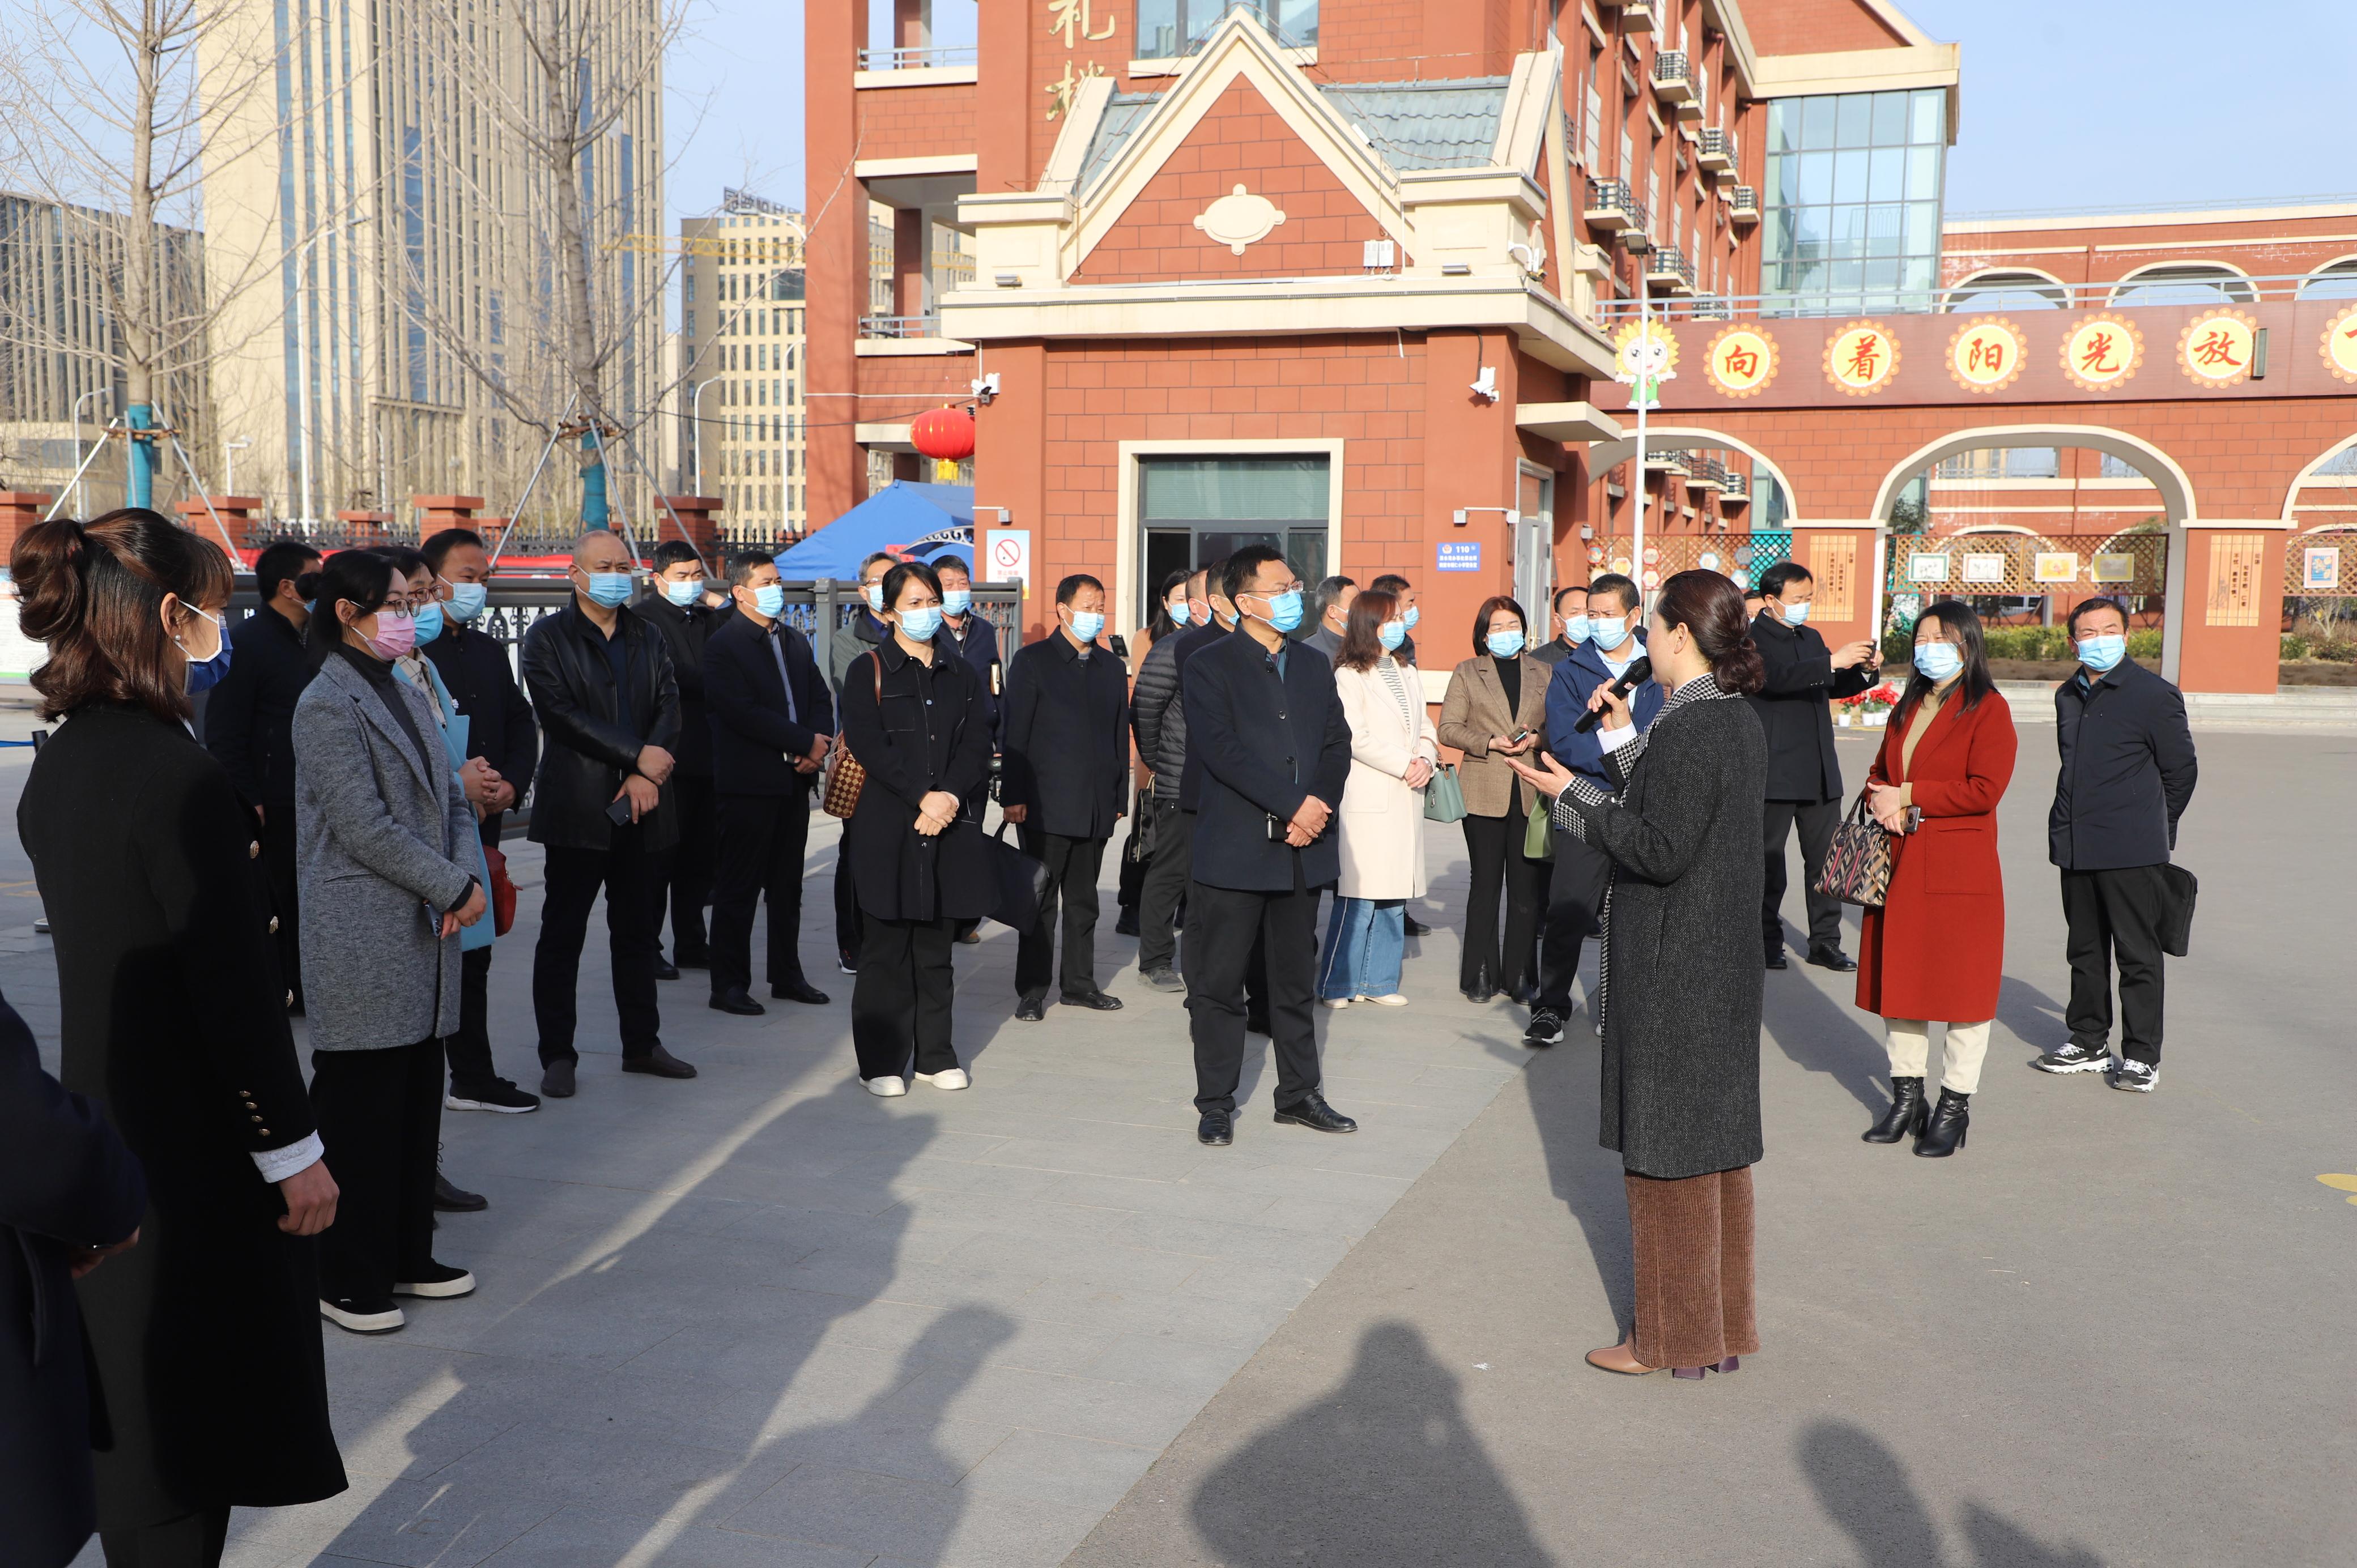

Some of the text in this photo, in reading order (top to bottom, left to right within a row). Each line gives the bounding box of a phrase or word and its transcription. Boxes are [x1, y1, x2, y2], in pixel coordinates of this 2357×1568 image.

[1724, 329, 2357, 381] 向着阳光放
